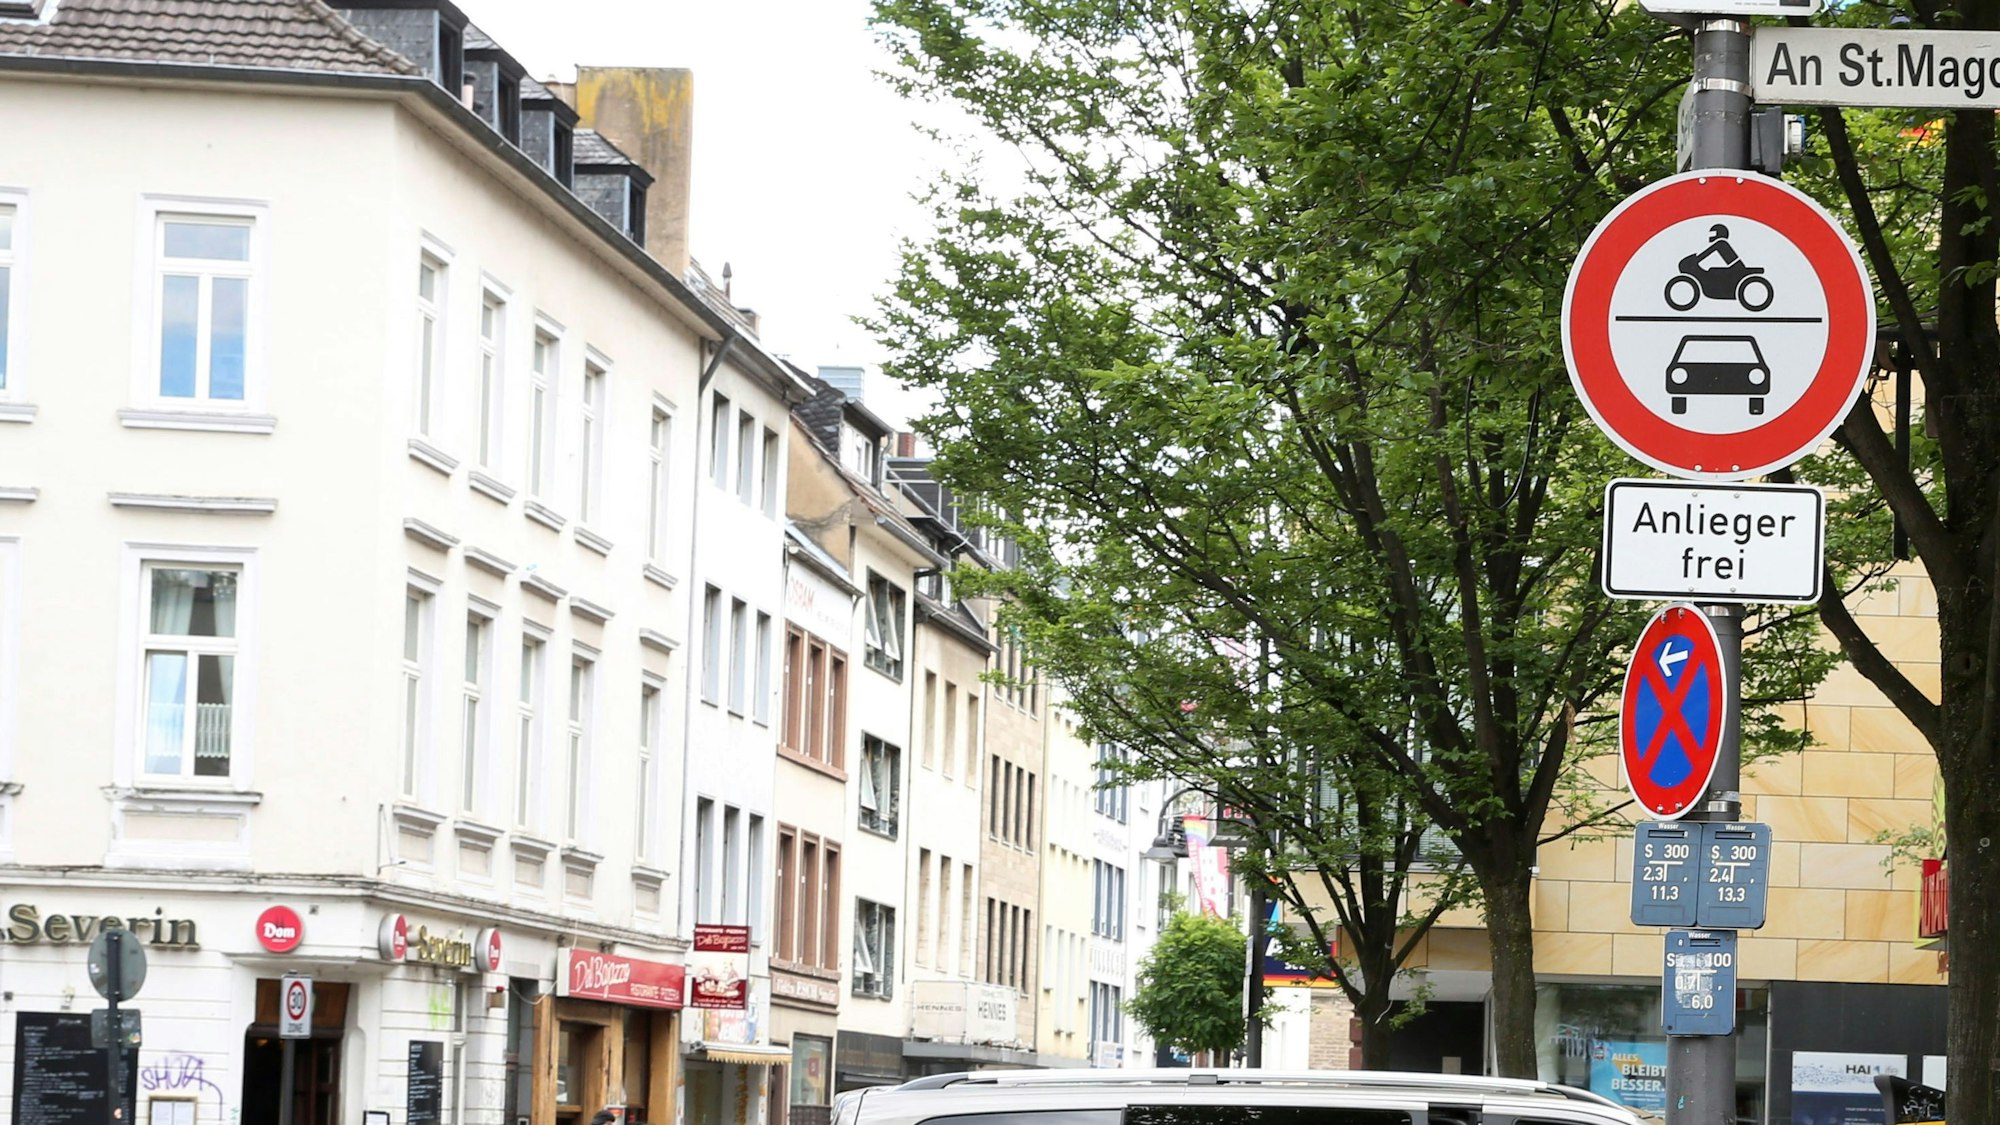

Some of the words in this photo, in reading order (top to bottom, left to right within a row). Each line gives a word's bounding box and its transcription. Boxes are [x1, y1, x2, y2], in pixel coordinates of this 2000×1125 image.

[1766, 43, 1822, 86] An
[1632, 502, 1796, 545] Anlieger
[1682, 547, 1744, 580] frei
[1644, 844, 1653, 858] S
[1663, 844, 1689, 859] 300
[1711, 845, 1720, 859] S
[1731, 846, 1756, 860] 300
[1643, 867, 1663, 881] 2,3
[1710, 868, 1729, 883] 2,4
[1652, 886, 1679, 900] 11,3
[1718, 887, 1745, 902] 13,3
[264, 922, 295, 938] Dom
[418, 925, 471, 966] Severin
[1666, 953, 1676, 967] S
[1705, 953, 1731, 967] 100
[291, 991, 303, 1010] 30
[1691, 994, 1713, 1010] 6,0
[978, 1001, 1006, 1020] HENNES
[1612, 1053, 1639, 1061] ALLES
[1622, 1064, 1667, 1077] BLEIBT
[1846, 1065, 1871, 1075] HAI
